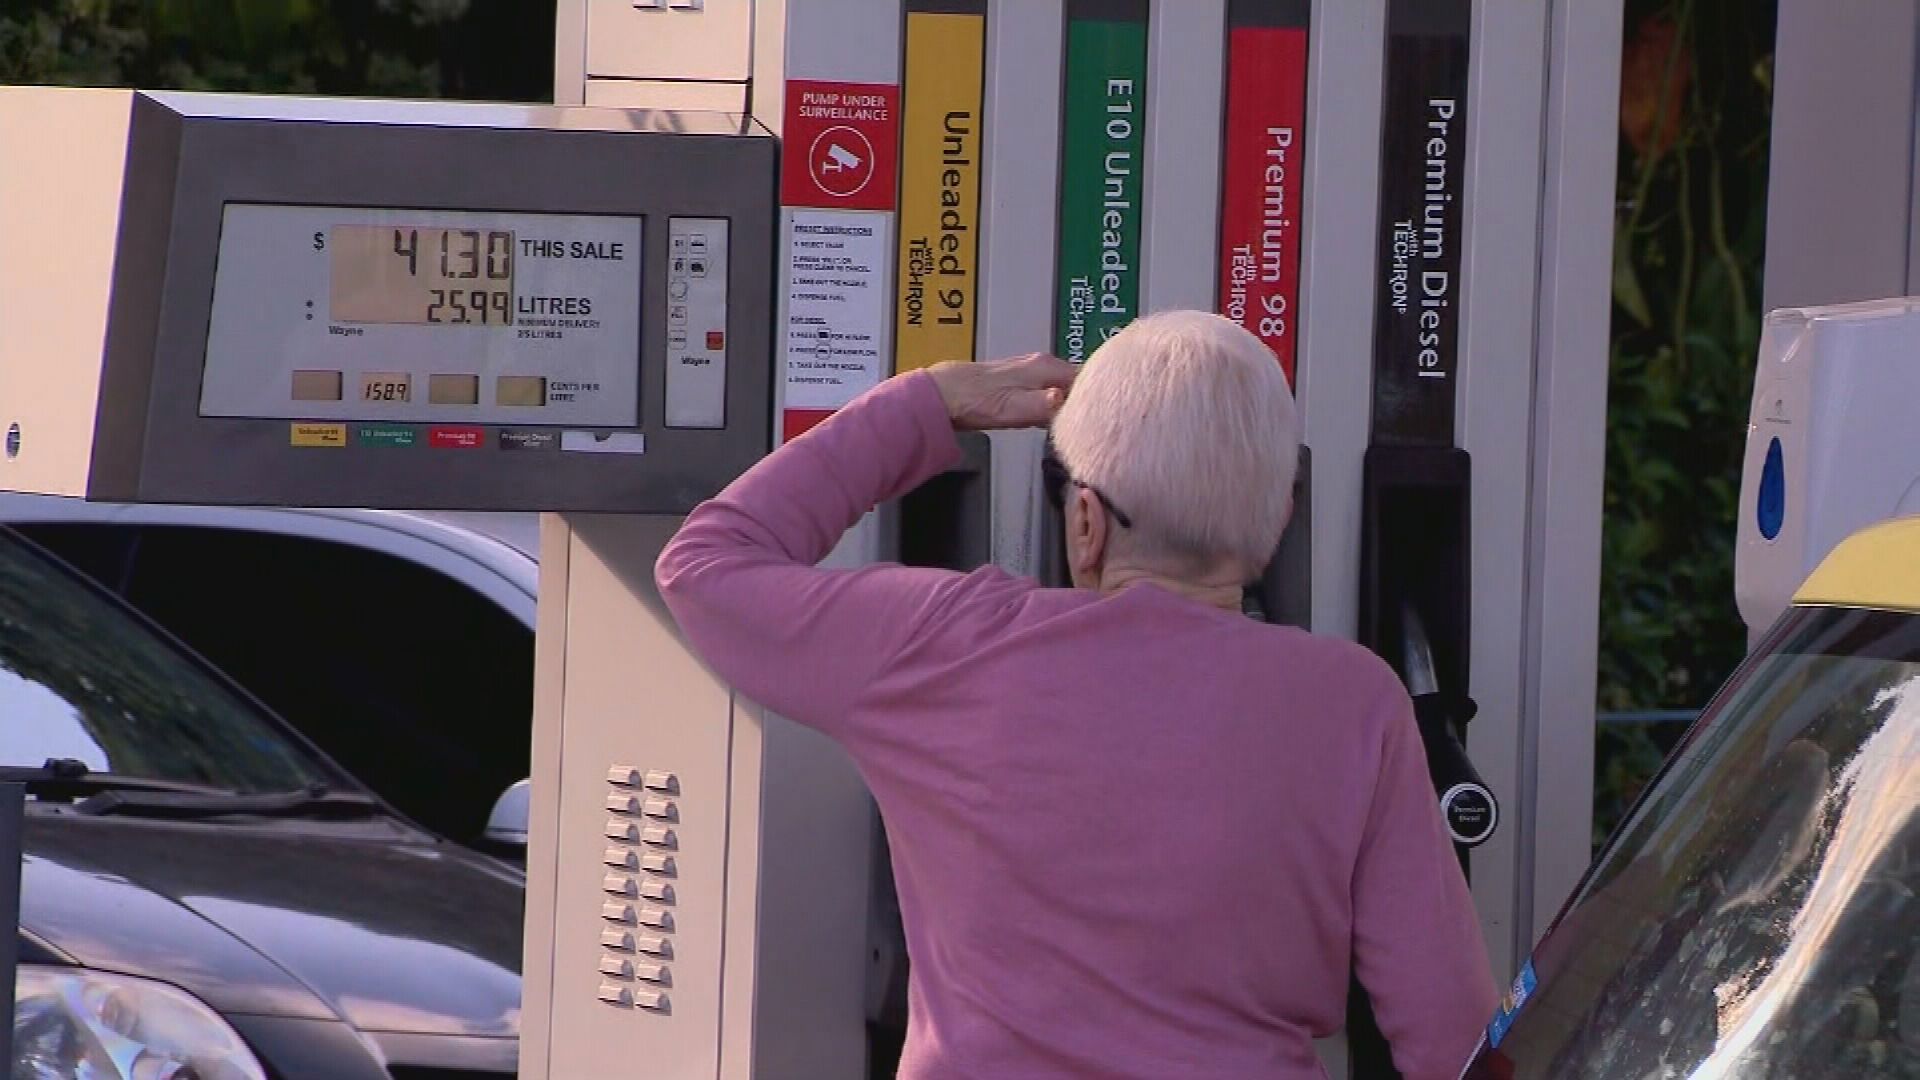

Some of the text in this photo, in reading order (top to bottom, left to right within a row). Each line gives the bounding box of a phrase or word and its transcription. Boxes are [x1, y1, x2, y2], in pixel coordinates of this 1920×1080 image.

[799, 106, 888, 121] SURVEILLANCE
[803, 92, 885, 107] PUMP UNDER
[1106, 79, 1133, 139] E10
[938, 111, 971, 324] Unleaded 91
[1259, 127, 1293, 337] Premium 98
[313, 231, 326, 252] $
[1100, 154, 1131, 313] Unleaded
[1409, 228, 1419, 257] with
[1418, 99, 1455, 377] Premium Diesel
[394, 229, 512, 279] 41.30
[521, 239, 624, 261] THIS SALE
[924, 247, 935, 275] with
[906, 237, 928, 325] TECHRON
[427, 289, 509, 324] 25.99
[518, 297, 592, 316] LITRES
[1084, 286, 1096, 313] with
[328, 325, 364, 338] Wayne
[1067, 275, 1089, 366] TECHRON
[364, 382, 407, 401] 158.9
